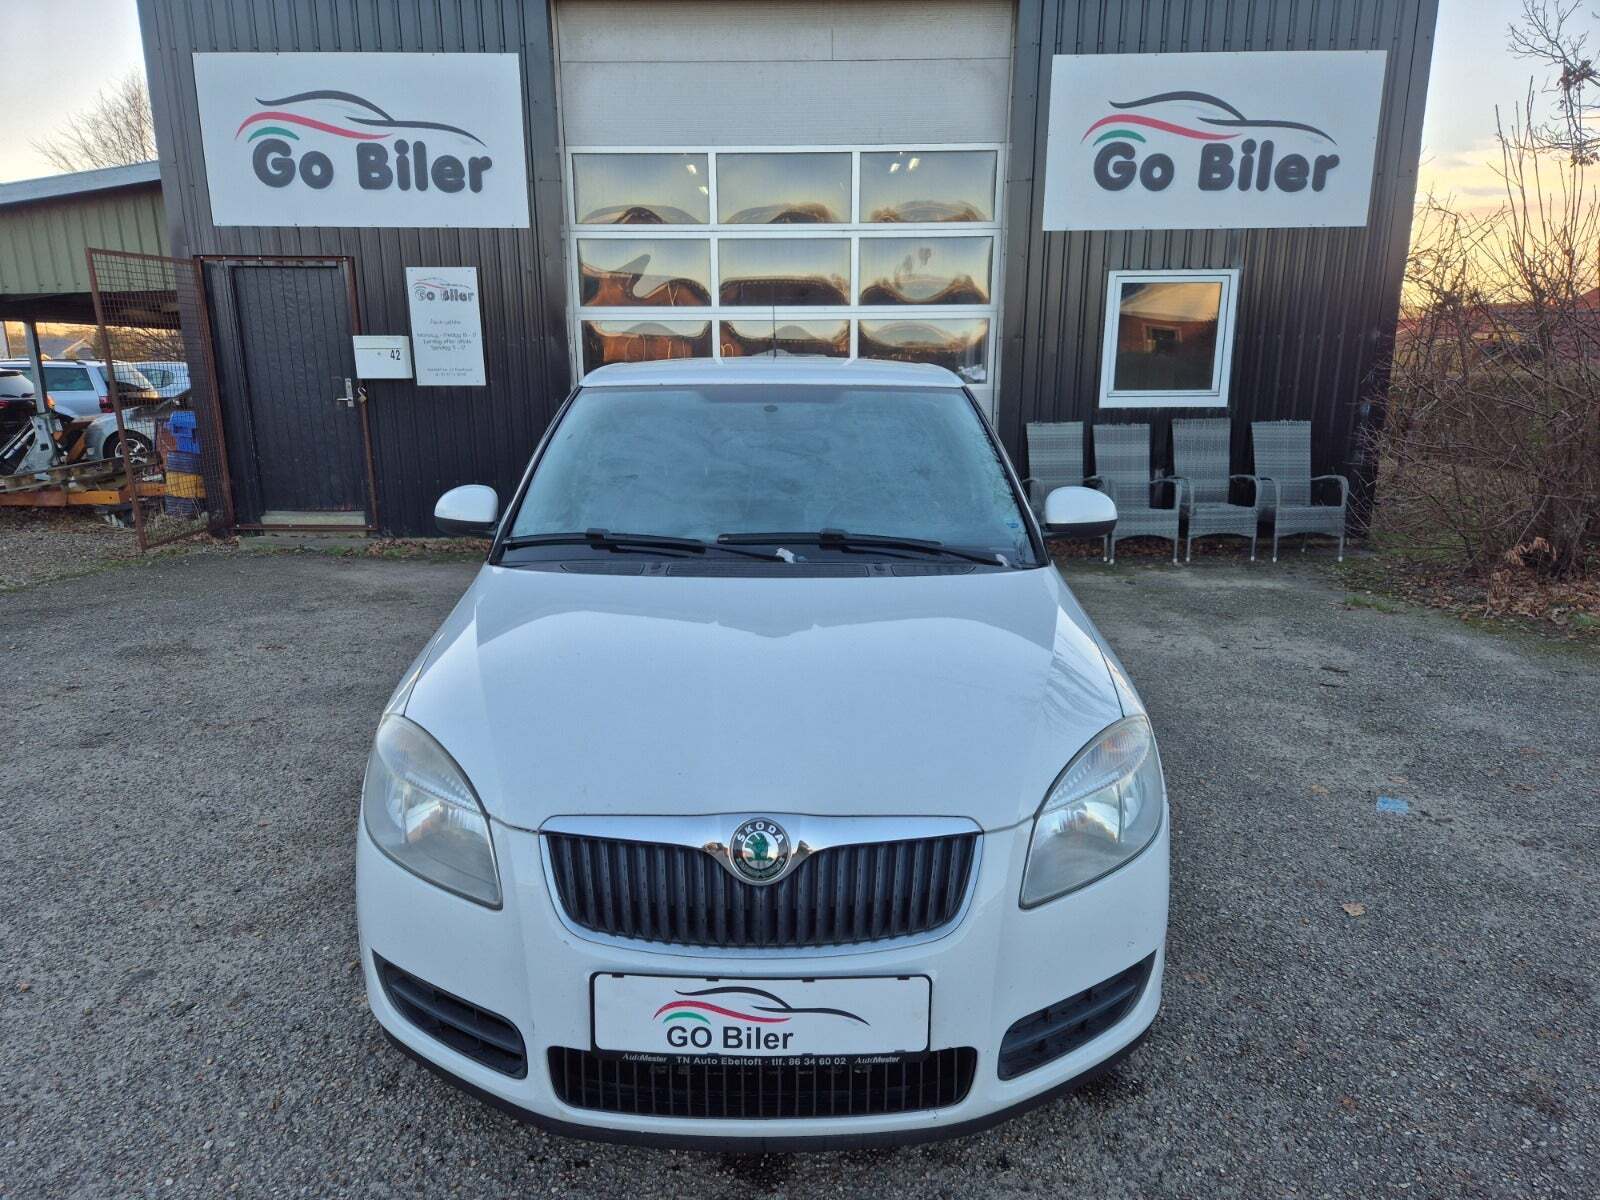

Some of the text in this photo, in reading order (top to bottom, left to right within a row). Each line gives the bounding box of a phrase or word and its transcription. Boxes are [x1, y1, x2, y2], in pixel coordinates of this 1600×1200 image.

[252, 138, 492, 193] Go Biler
[1093, 138, 1340, 192] Go Biler
[390, 349, 401, 361] 42
[666, 1025, 794, 1050] GO Biler
[676, 1056, 690, 1064] TN
[693, 1056, 718, 1065] Auto
[721, 1057, 762, 1066] Ebeltoft
[804, 1057, 816, 1066] 34
[834, 1056, 847, 1065] 02
